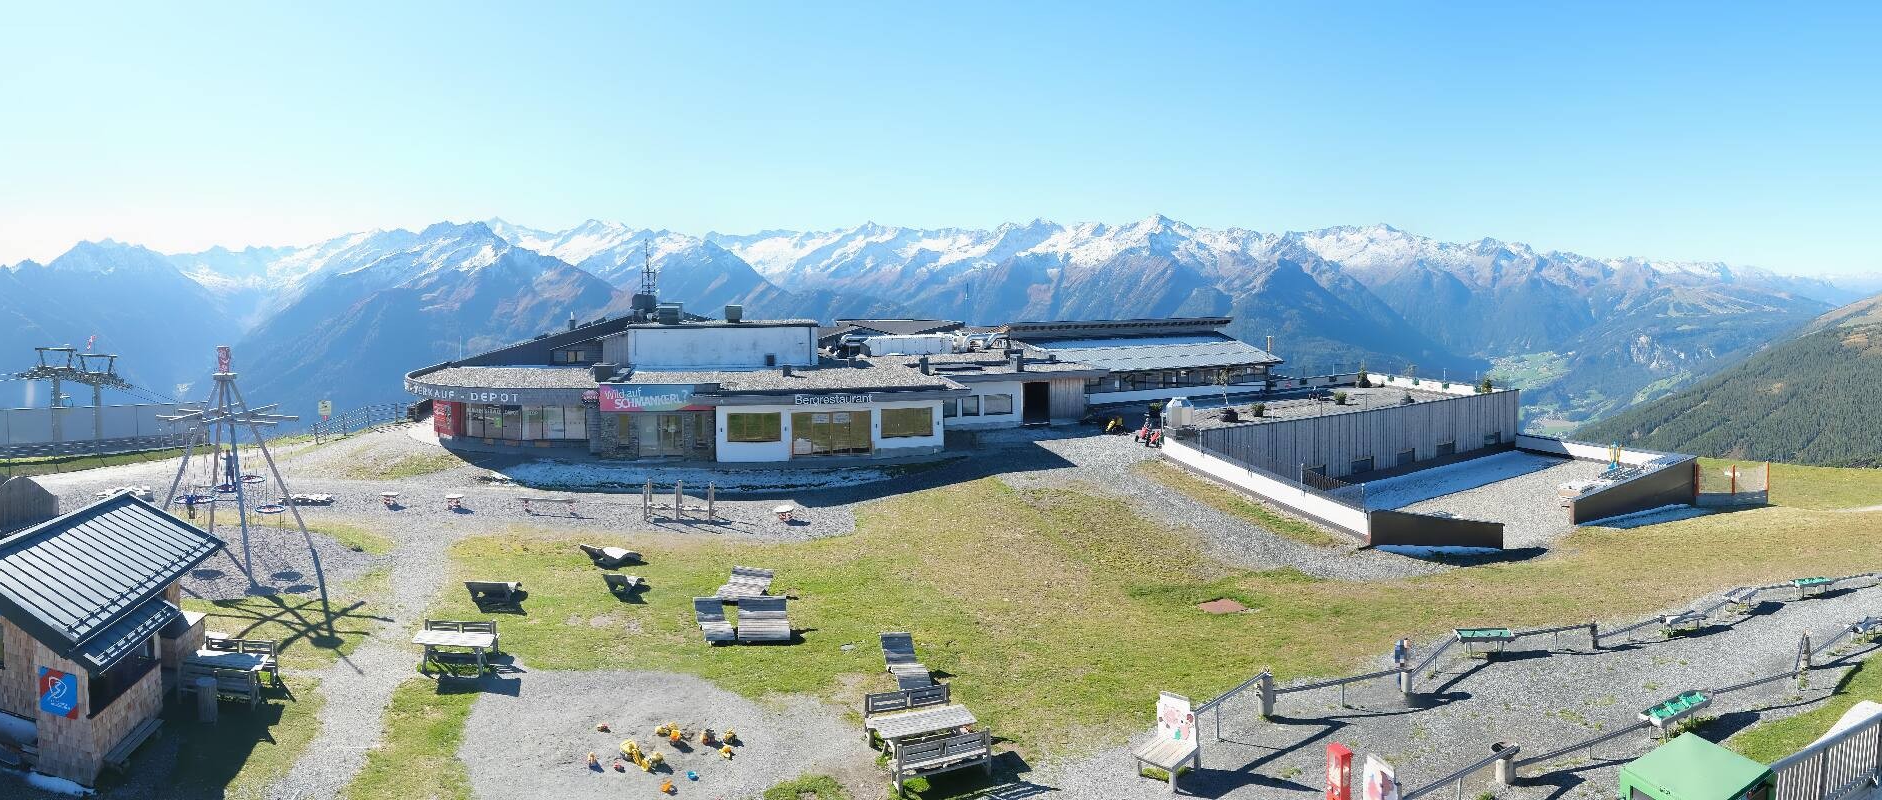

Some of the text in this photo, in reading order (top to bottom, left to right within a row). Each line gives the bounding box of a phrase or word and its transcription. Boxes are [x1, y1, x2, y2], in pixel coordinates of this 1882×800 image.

[414, 385, 455, 399] VERKAUF
[470, 393, 519, 402] DEPOT
[605, 388, 625, 400] Wild
[626, 386, 642, 398] auf
[795, 394, 873, 405] Bergrestaurant
